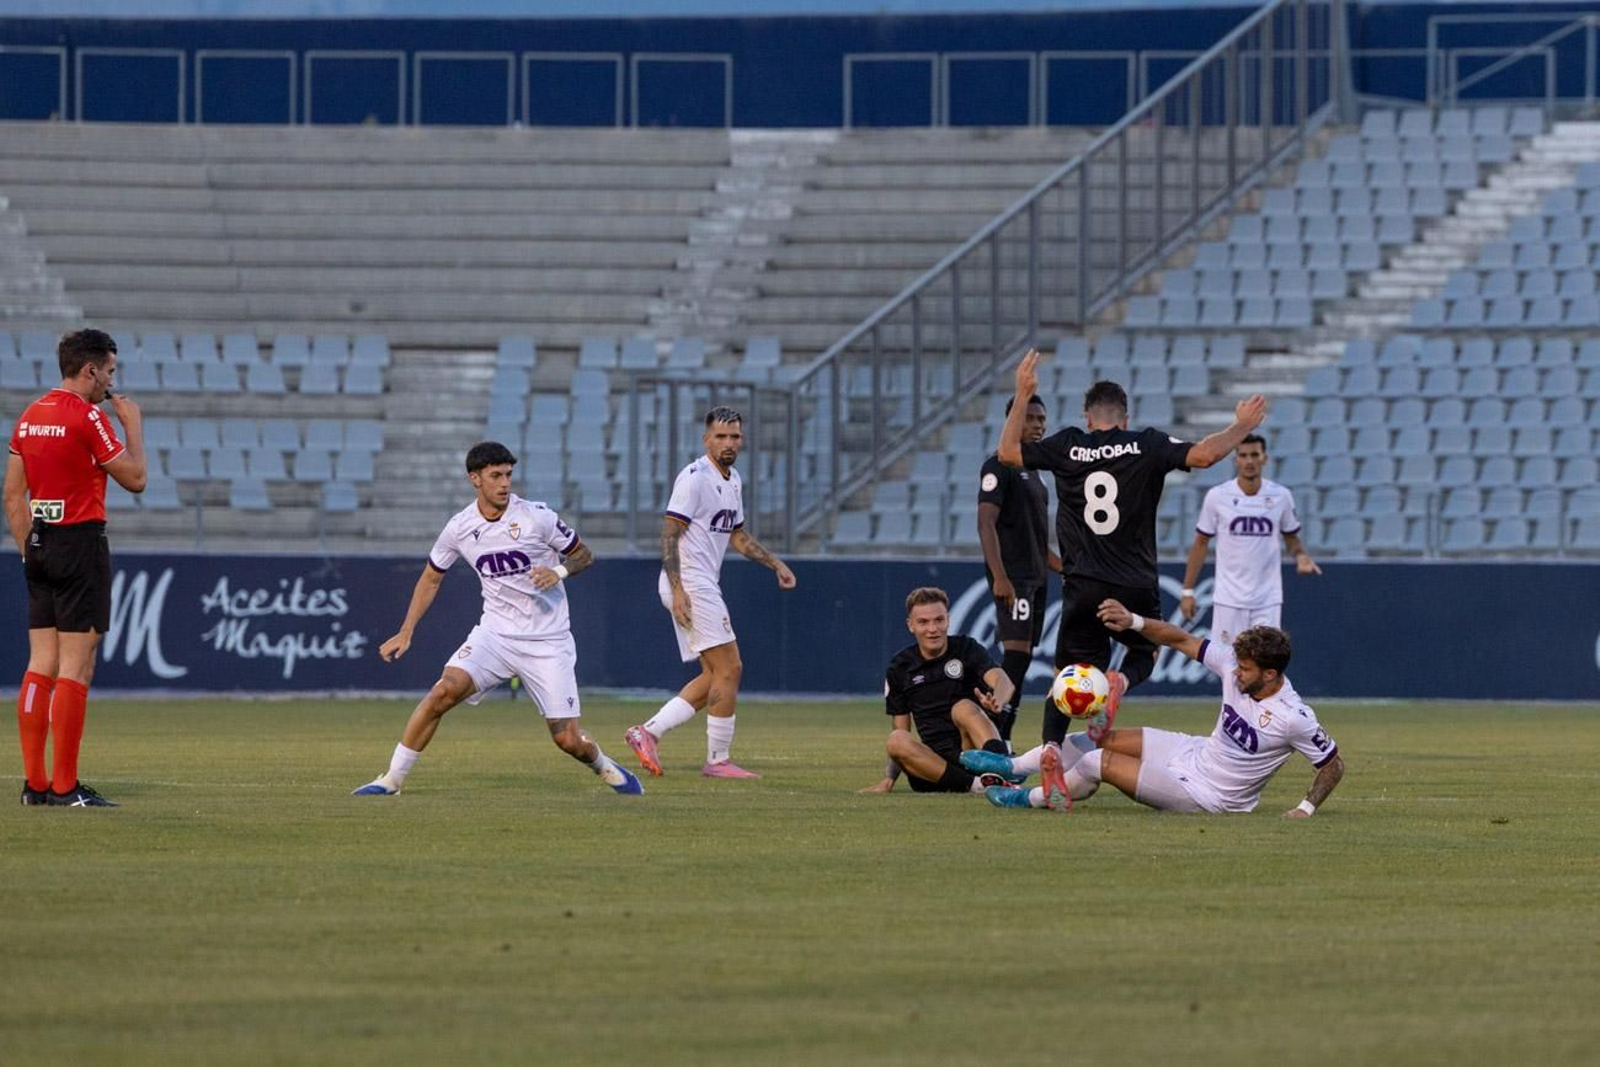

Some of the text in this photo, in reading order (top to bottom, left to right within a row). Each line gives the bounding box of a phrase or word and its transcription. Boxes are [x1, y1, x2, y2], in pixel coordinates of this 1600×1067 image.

[1069, 441, 1142, 463] CRISTOBAL
[1083, 470, 1121, 536] 8
[201, 575, 349, 617] Aceites
[1012, 597, 1030, 620] 19
